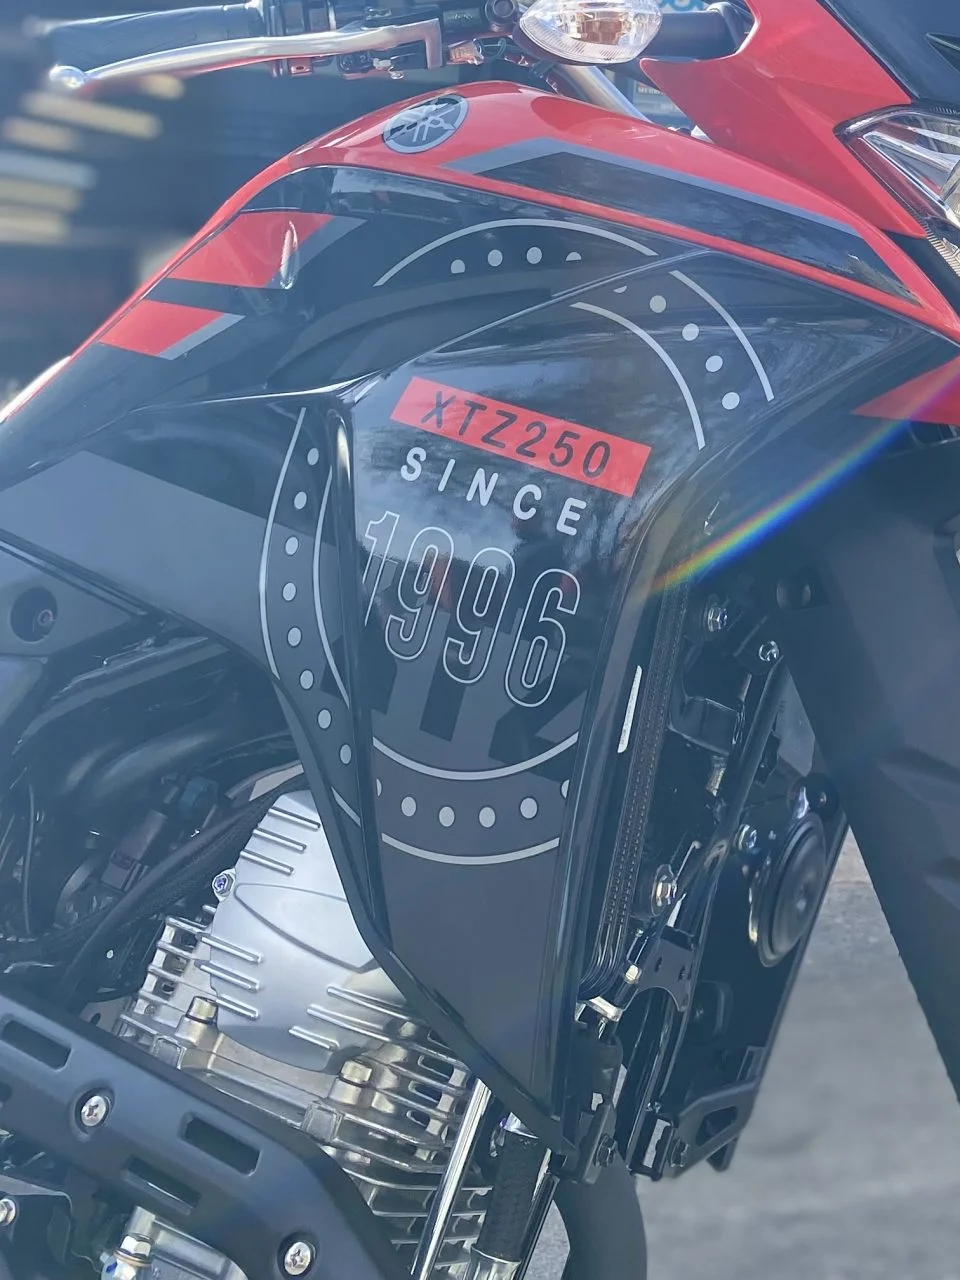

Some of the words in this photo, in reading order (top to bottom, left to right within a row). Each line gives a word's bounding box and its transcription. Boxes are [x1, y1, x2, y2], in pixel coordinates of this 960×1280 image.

[419, 390, 612, 479] XTZ250
[400, 446, 588, 536] SINCE
[362, 510, 581, 708] 1996
